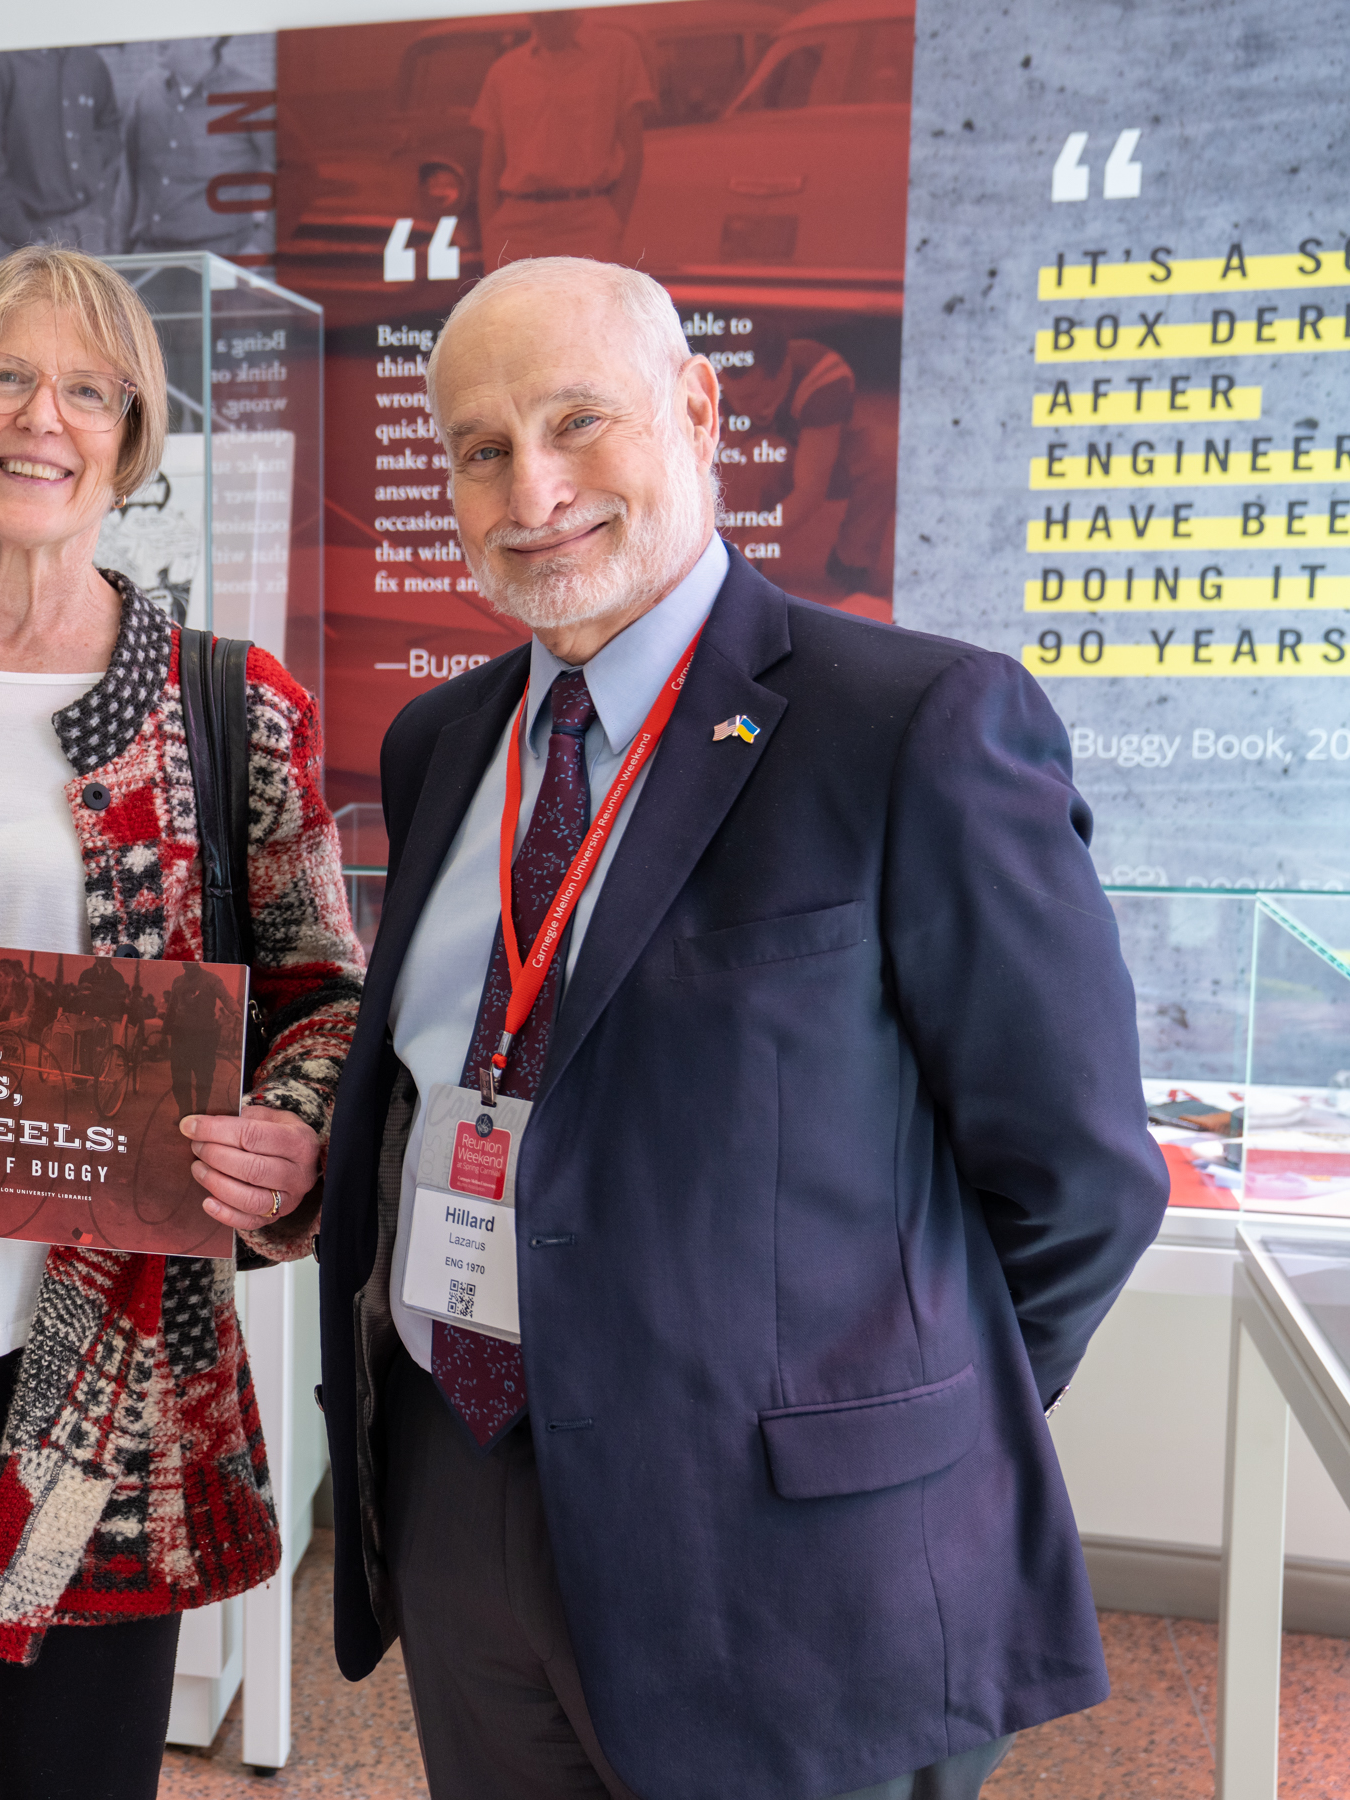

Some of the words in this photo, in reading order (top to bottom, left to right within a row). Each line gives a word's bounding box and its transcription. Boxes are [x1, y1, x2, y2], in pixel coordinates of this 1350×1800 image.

[1056, 246, 1173, 288] IT'S
[1221, 242, 1248, 280] A
[377, 325, 434, 352] Being
[682, 312, 726, 337] able
[730, 317, 754, 336] to
[1052, 311, 1164, 351] BOX
[1210, 304, 1350, 346] DER
[376, 354, 429, 378] think
[709, 350, 755, 374] goes
[1049, 374, 1236, 416] AFTER
[728, 414, 752, 432] to
[376, 447, 428, 470] make
[753, 439, 788, 463] the
[375, 484, 442, 501] answer
[1044, 502, 1194, 541] HAVE
[375, 540, 413, 562] that
[418, 539, 462, 562] with
[744, 542, 781, 559] can
[375, 570, 399, 593] fix
[404, 576, 452, 593] most
[456, 576, 485, 597] an
[1040, 565, 1224, 603] DOING
[1272, 564, 1327, 601] IT
[1038, 629, 1106, 665] 90
[1149, 627, 1347, 665] YEARS
[1072, 726, 1182, 769] Buggy
[1191, 726, 1293, 765] Book,
[531, 919, 560, 969] Carnegie
[552, 880, 578, 920] Mellon
[571, 828, 605, 882] University
[598, 782, 626, 827] Reunion
[620, 732, 652, 782] Weekend
[457, 1146, 504, 1169] Weekend
[461, 1133, 503, 1155] Reunion
[32, 1160, 109, 1183] BUGGY
[463, 1161, 480, 1175] Spring
[16, 1188, 56, 1198] UNIVERSITY
[57, 1193, 92, 1202] LIBRARIES
[445, 1205, 496, 1233] Hillard
[449, 1232, 486, 1252] Lazarus
[445, 1256, 464, 1270] ENG
[466, 1262, 486, 1275] 1970
